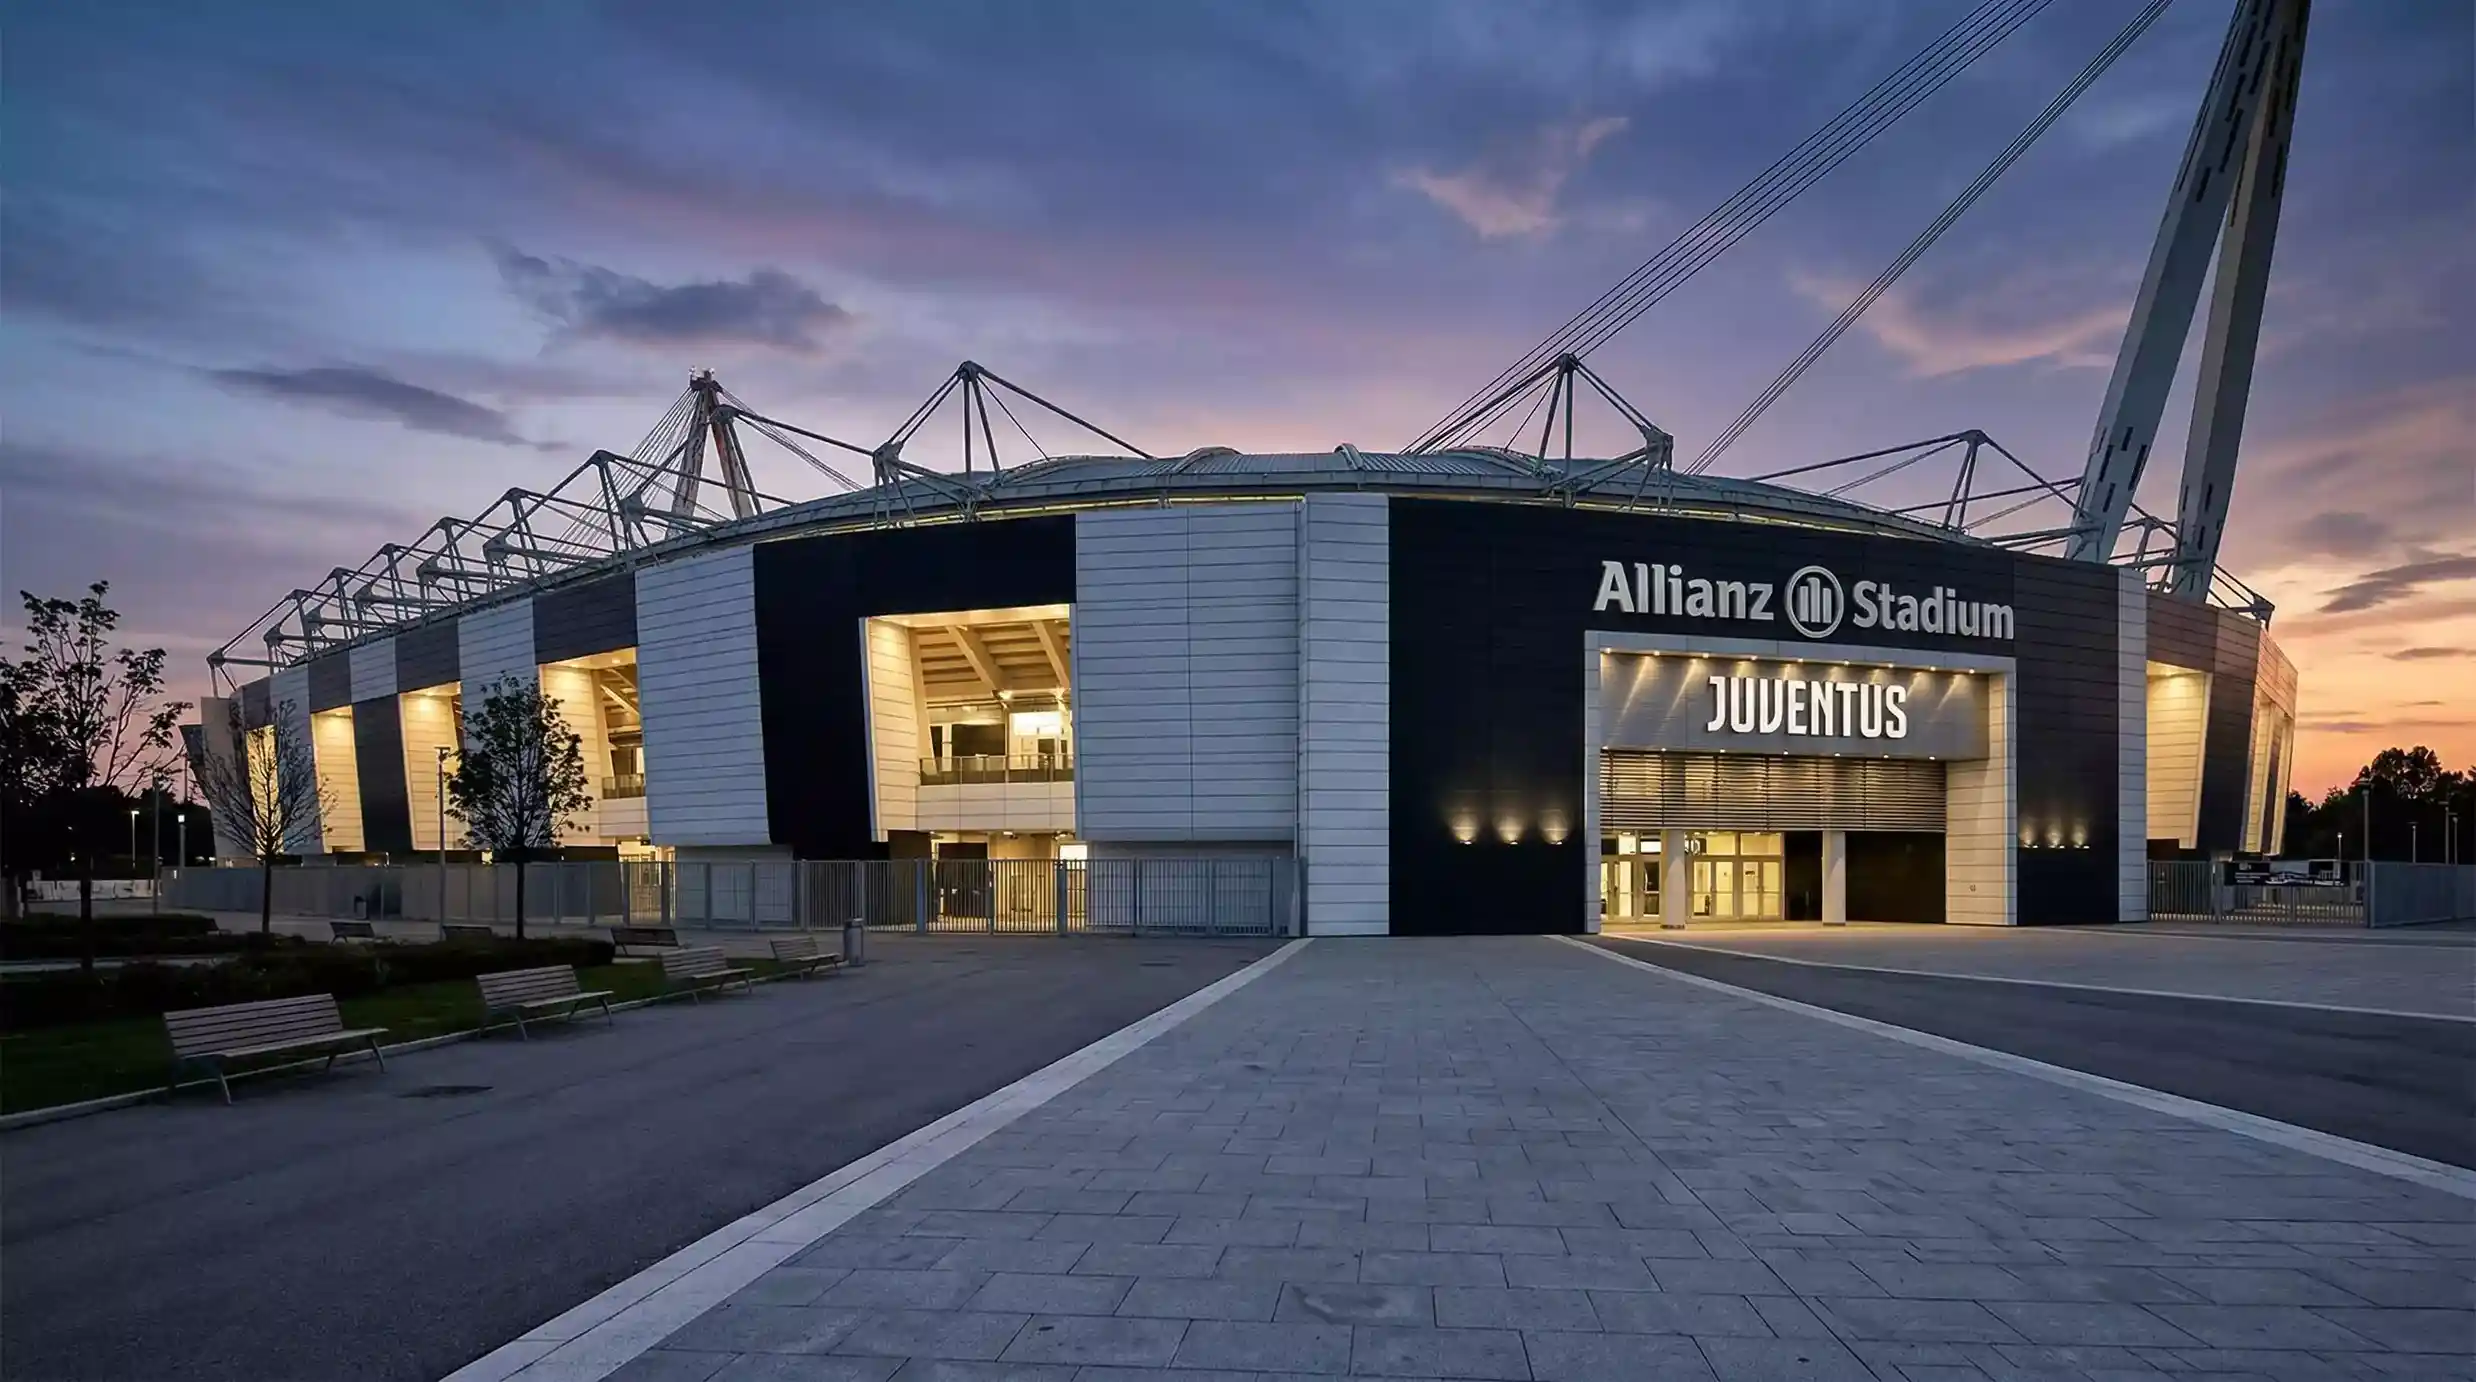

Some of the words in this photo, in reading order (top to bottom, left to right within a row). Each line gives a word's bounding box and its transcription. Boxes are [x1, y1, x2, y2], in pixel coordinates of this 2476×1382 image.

[1593, 561, 1774, 620] Allianz
[1853, 580, 2014, 639] Stadium
[1708, 676, 1907, 738] JUVENTUS
